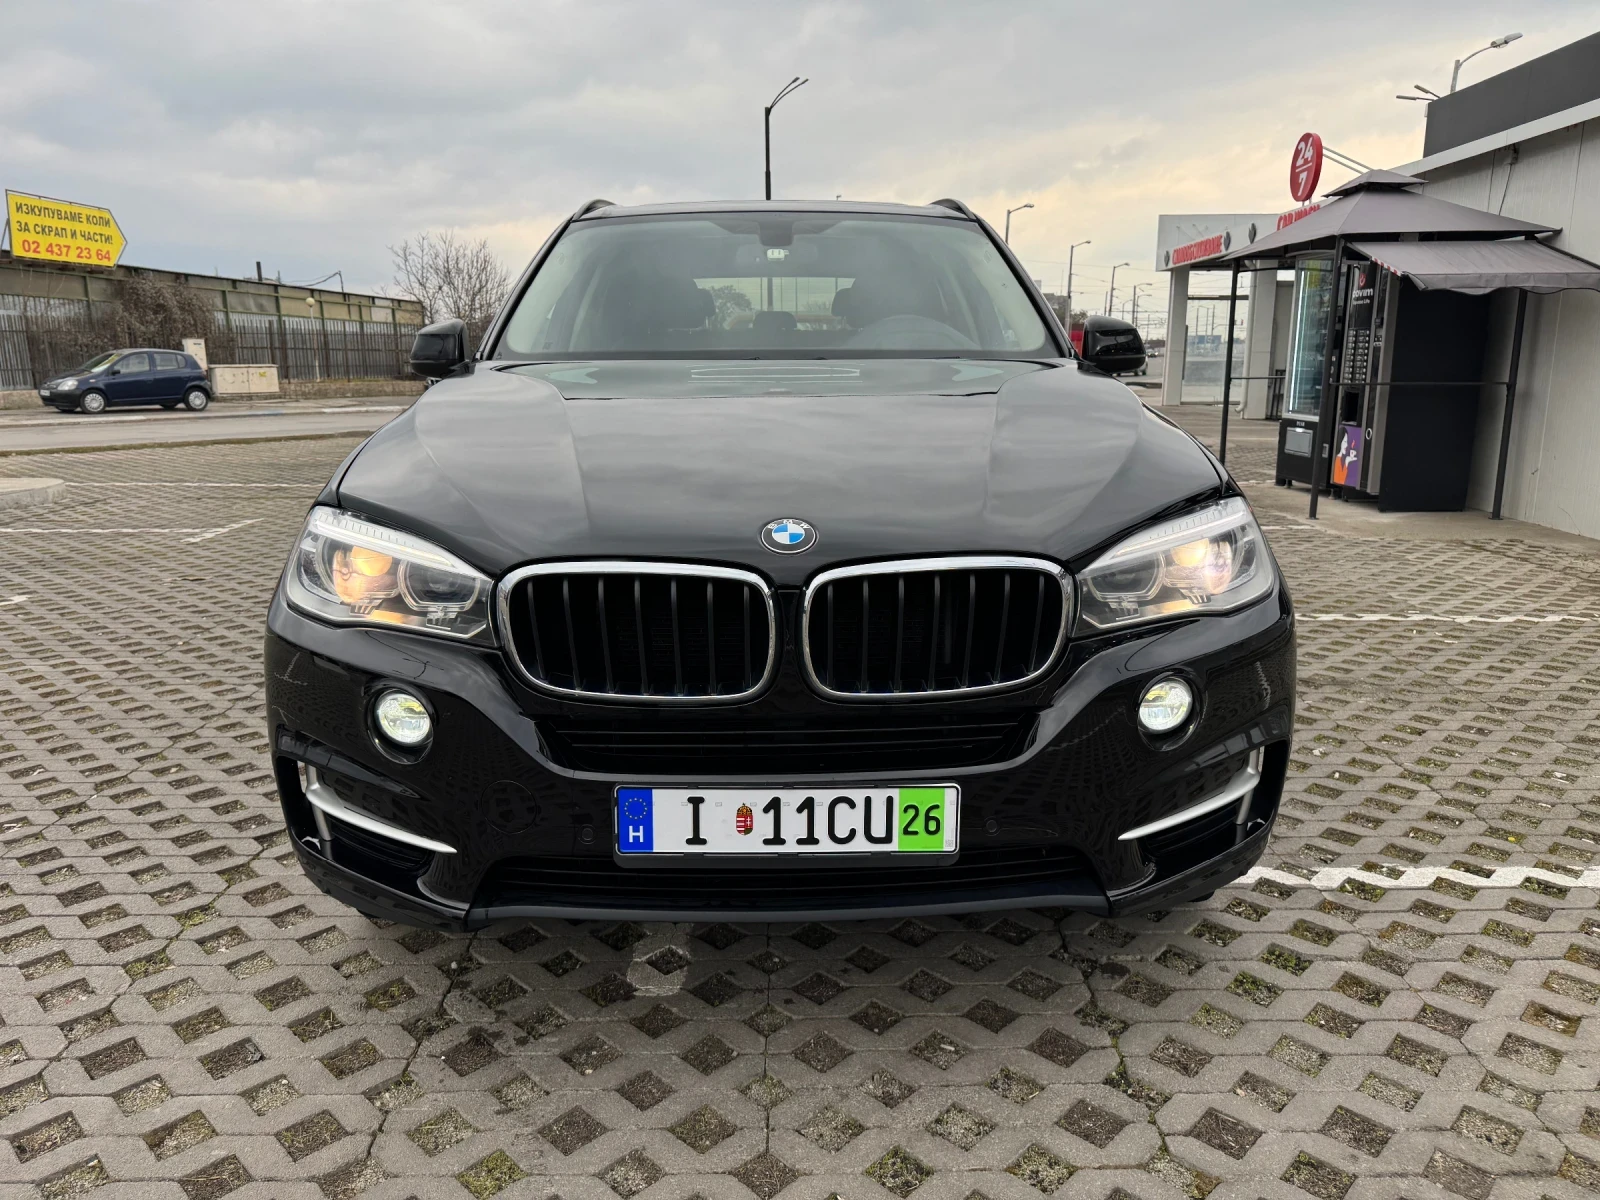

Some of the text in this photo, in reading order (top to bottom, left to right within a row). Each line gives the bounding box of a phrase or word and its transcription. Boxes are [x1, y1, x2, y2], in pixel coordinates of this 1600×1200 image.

[1296, 137, 1313, 166] 24
[1297, 171, 1308, 196] 7
[15, 202, 111, 228] ИЗКУПУВАМЕ КОЛИ
[16, 220, 113, 245] ЗА СКРАП И ЧАСТИ!
[22, 239, 111, 262] 02 437 23 64
[685, 795, 941, 846] I 11CU 26
[628, 825, 644, 843] H
